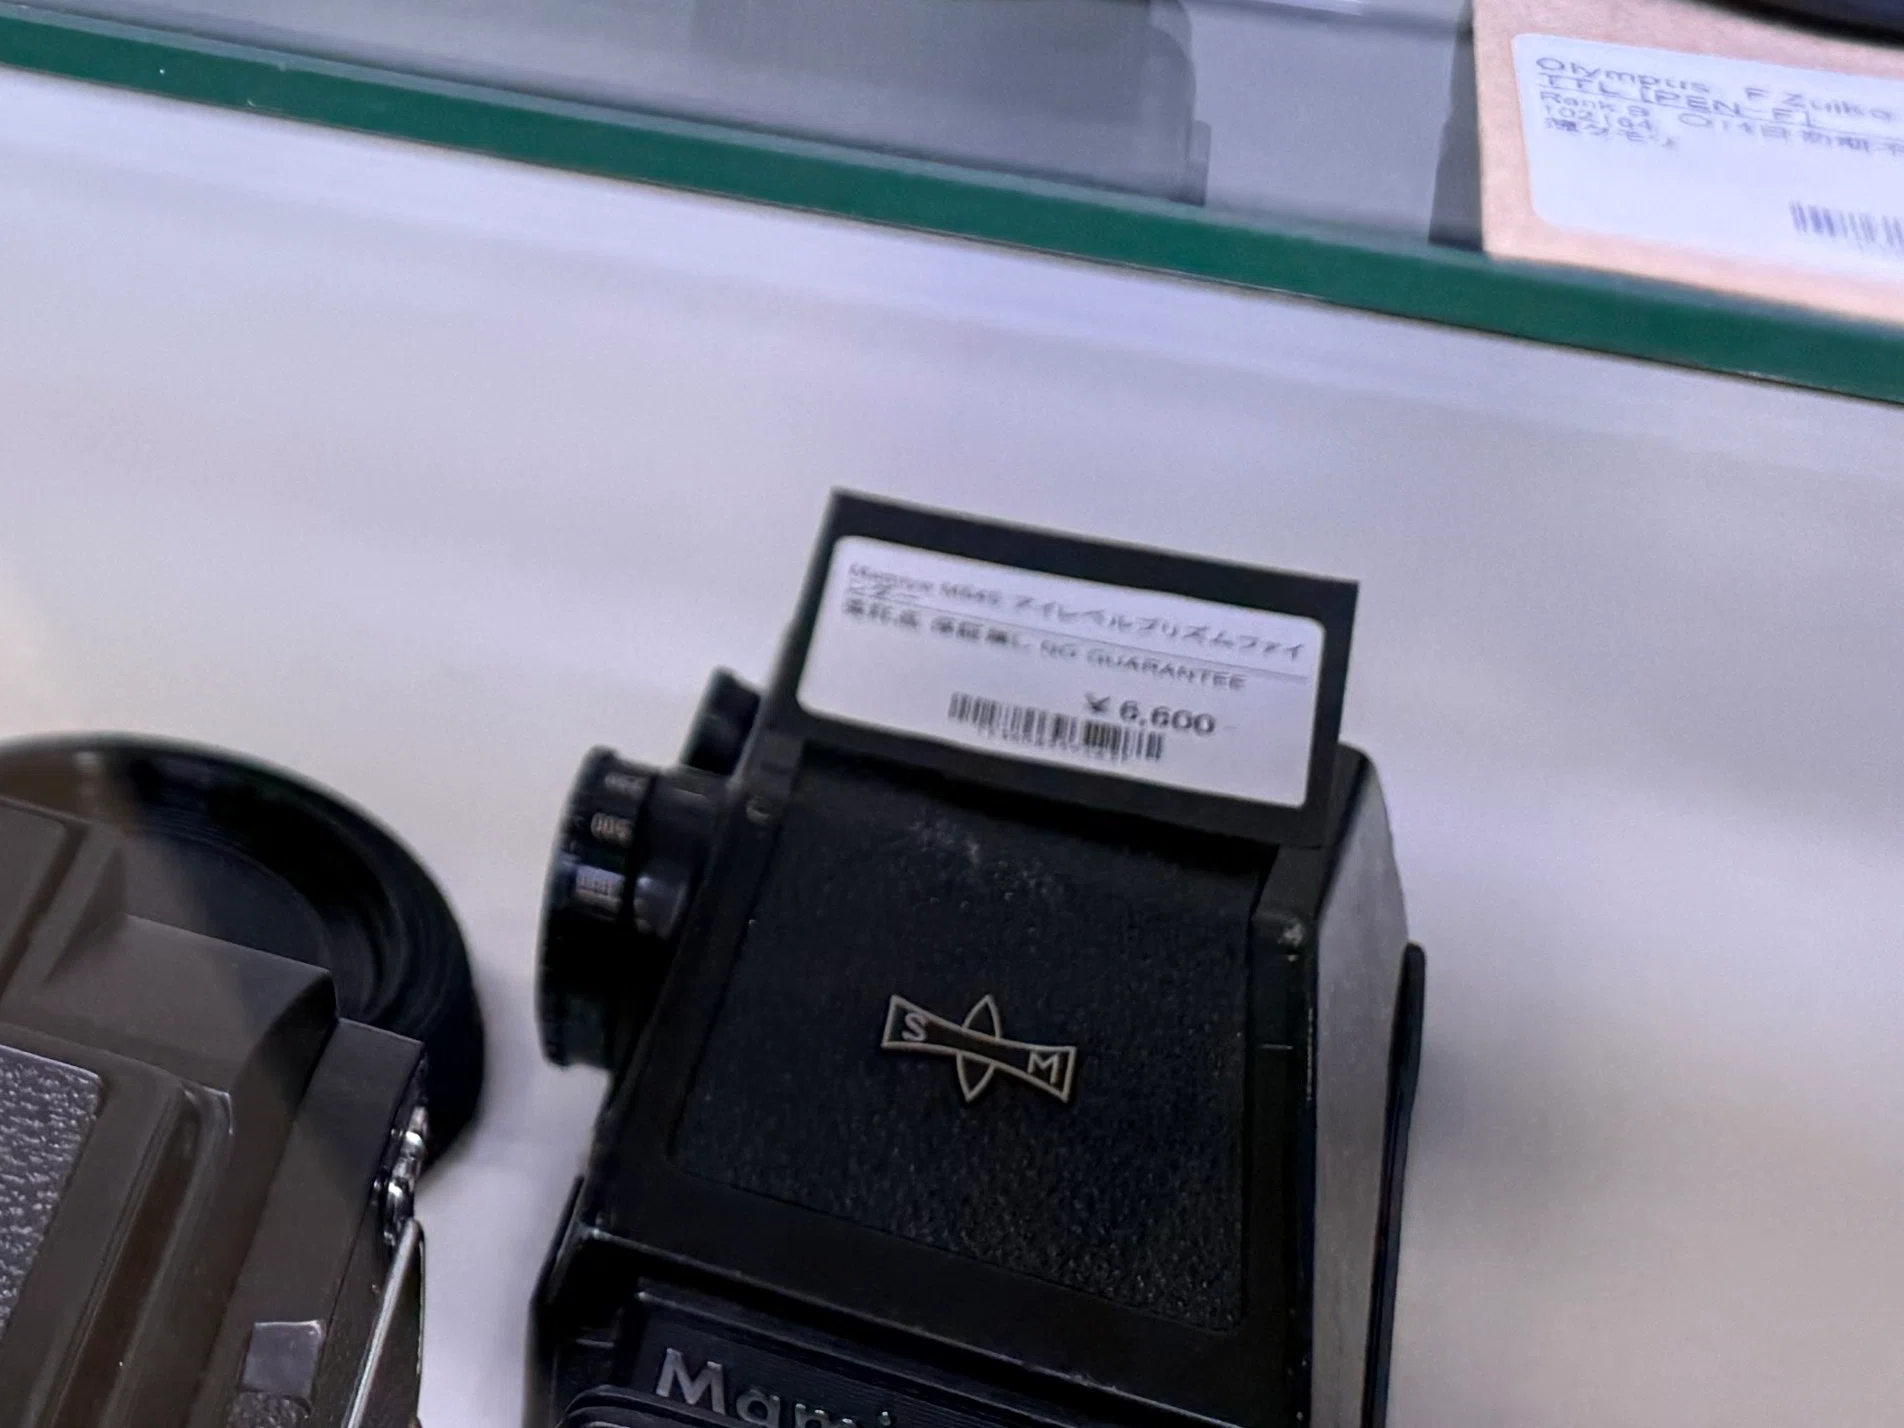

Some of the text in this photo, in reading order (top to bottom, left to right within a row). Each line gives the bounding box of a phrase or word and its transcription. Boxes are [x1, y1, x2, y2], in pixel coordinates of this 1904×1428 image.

[1535, 57, 1711, 93] Olympus
[1040, 640, 1078, 661] NO
[1087, 648, 1247, 690] GUARANTEE
[1084, 692, 1218, 736] ¥6,600
